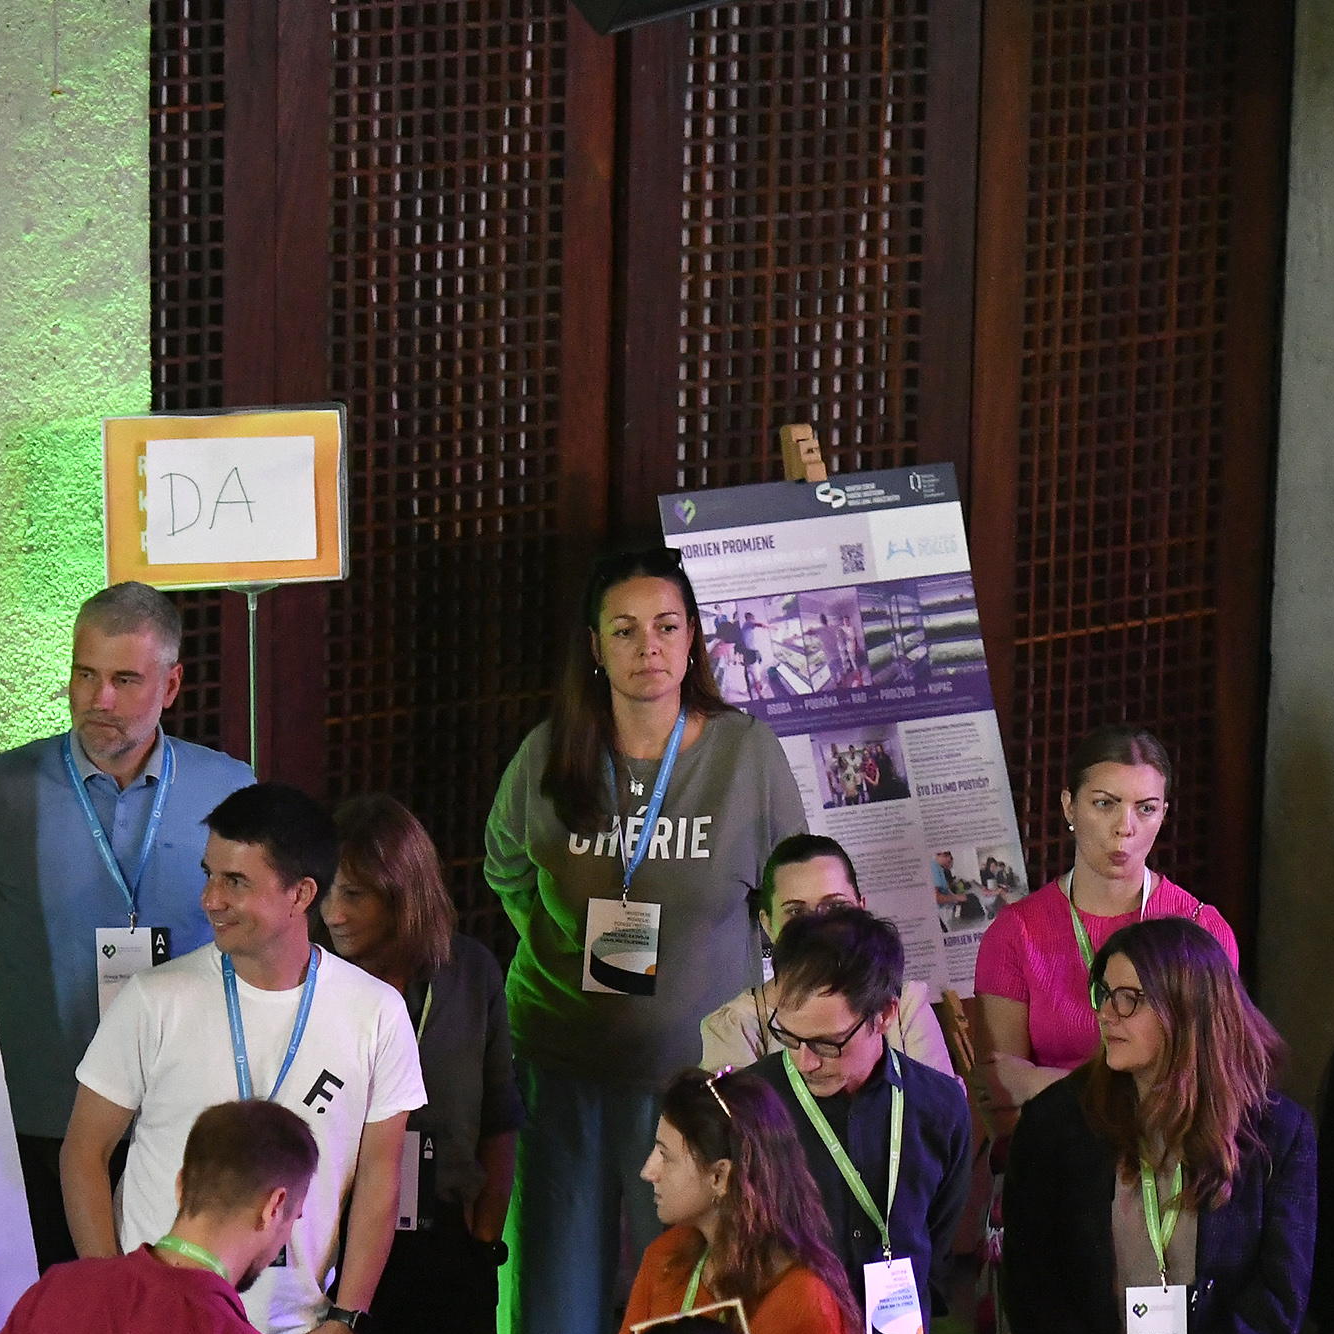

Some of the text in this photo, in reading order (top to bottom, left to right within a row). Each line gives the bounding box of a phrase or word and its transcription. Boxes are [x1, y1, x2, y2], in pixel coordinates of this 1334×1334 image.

[160, 466, 256, 537] DA
[722, 535, 775, 555] PROMJENE
[931, 781, 958, 796] ŽELIMO
[156, 933, 165, 946] A
[424, 1137, 433, 1149] A
